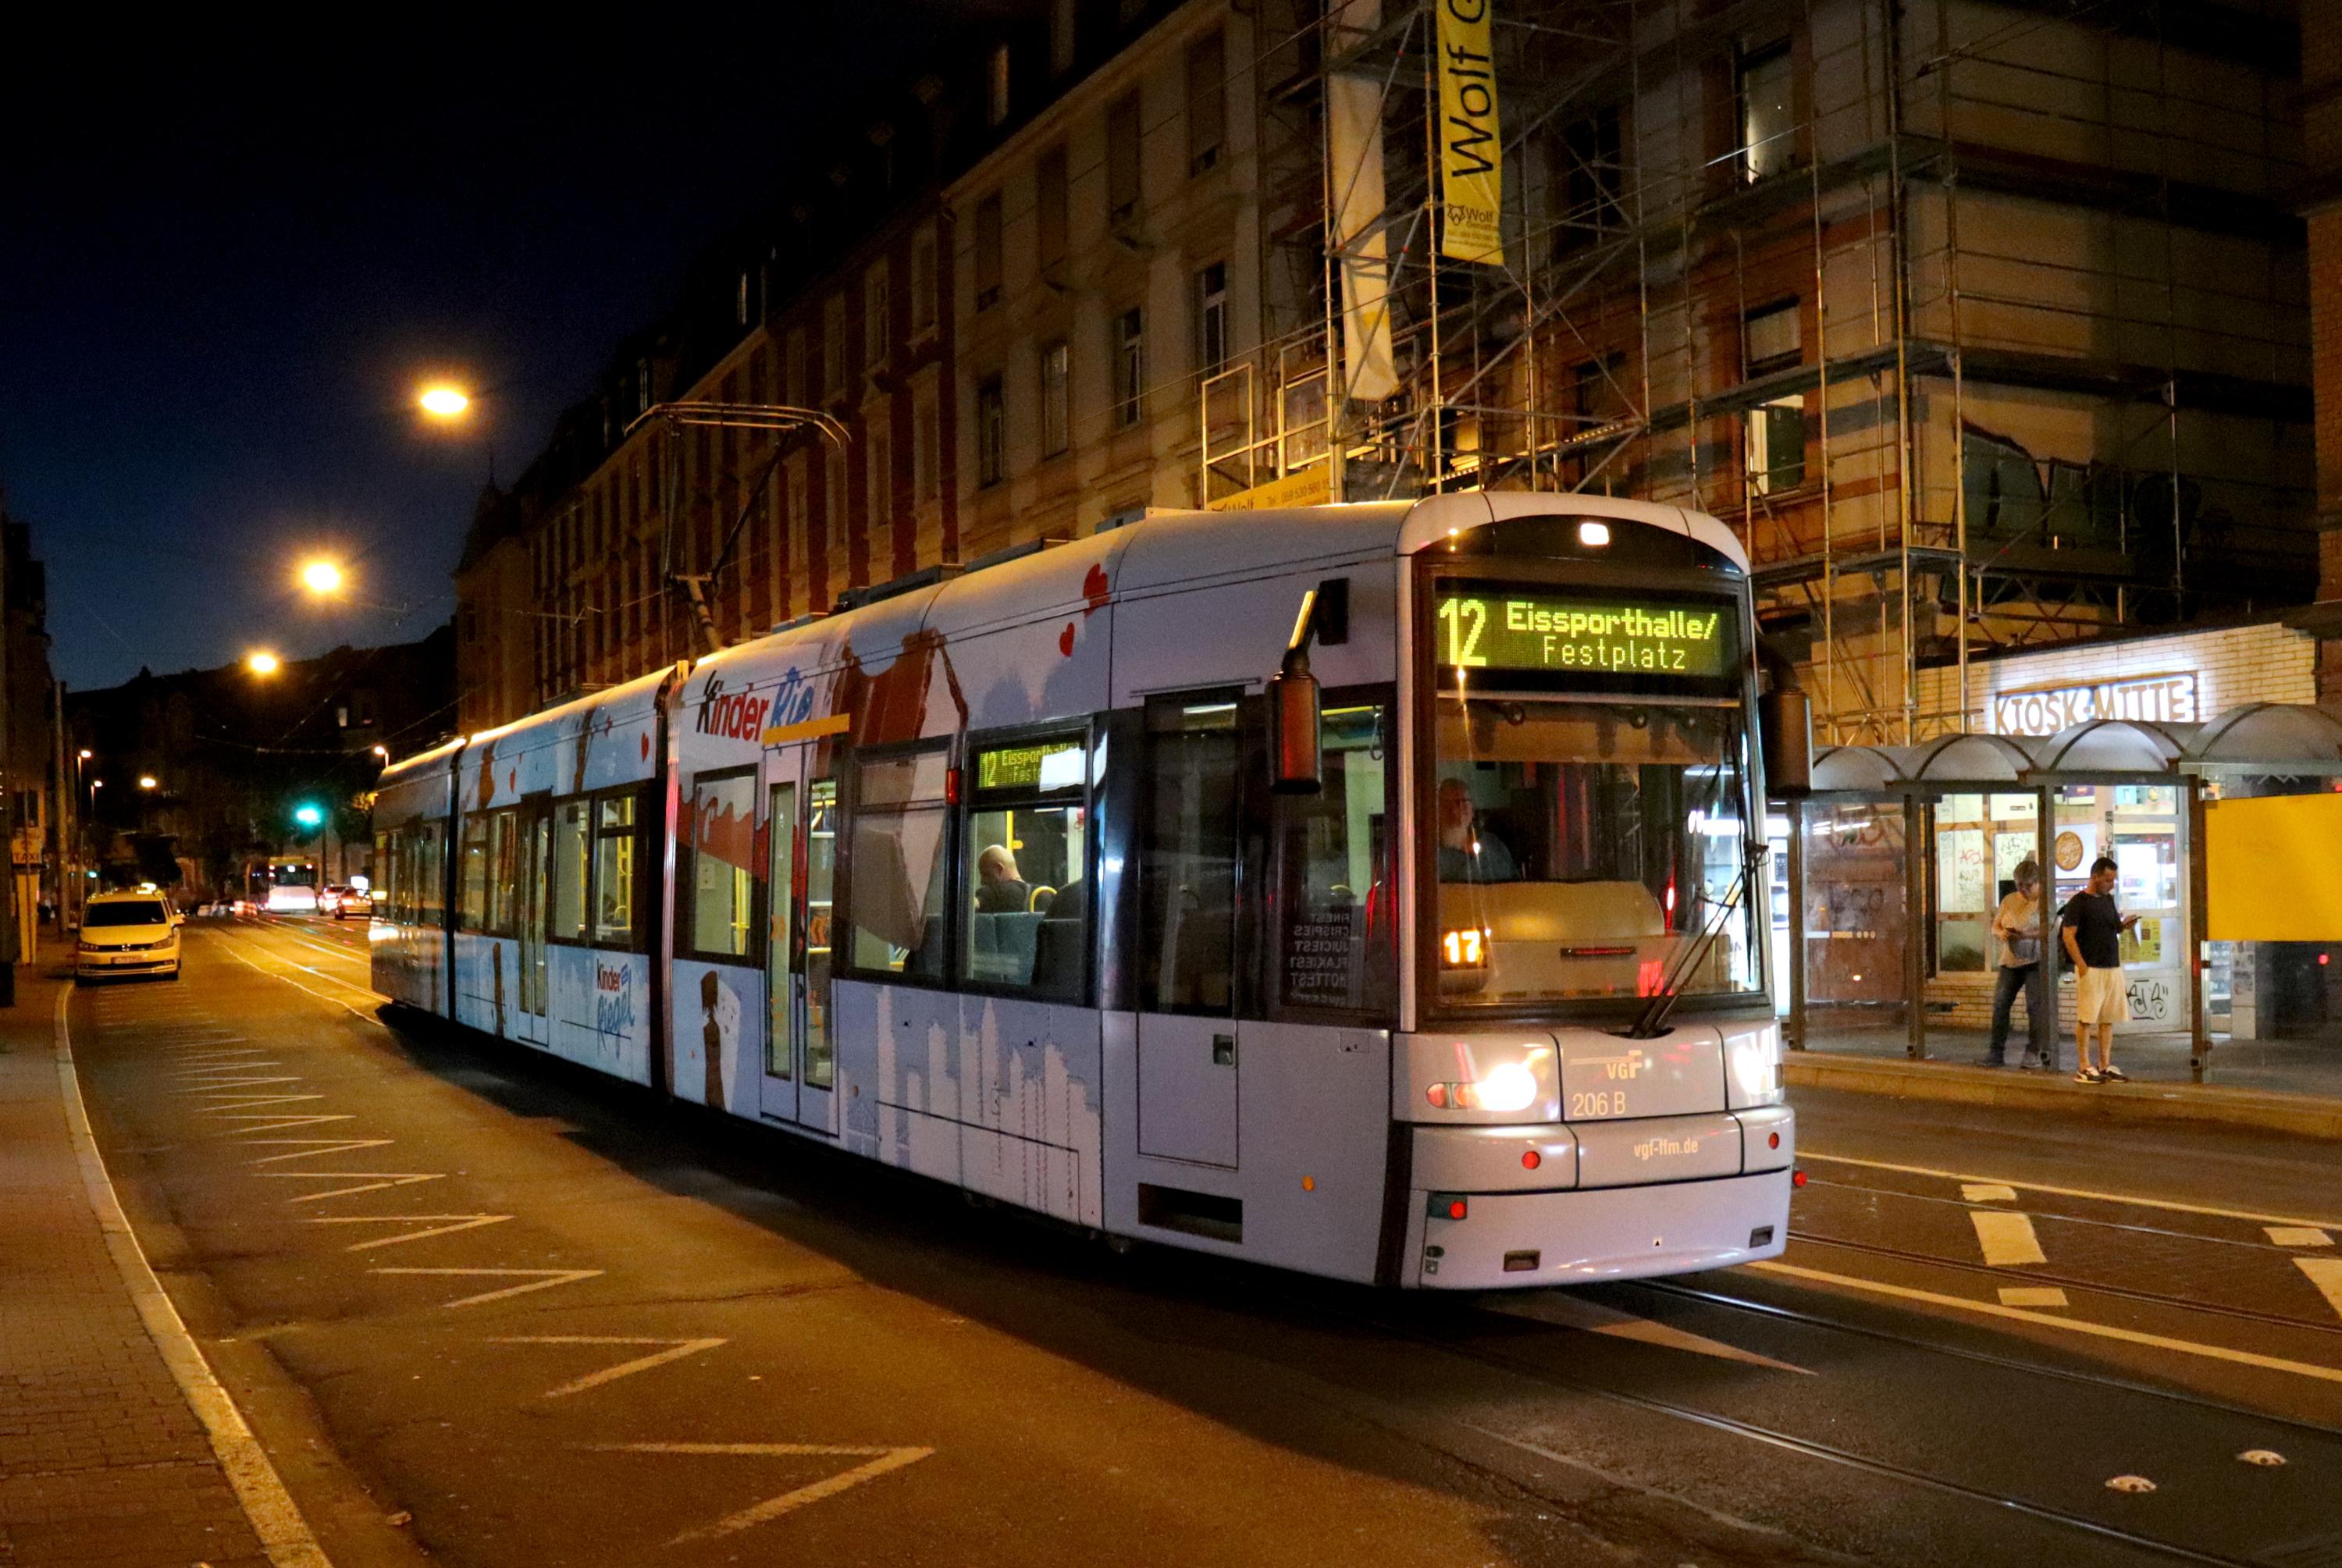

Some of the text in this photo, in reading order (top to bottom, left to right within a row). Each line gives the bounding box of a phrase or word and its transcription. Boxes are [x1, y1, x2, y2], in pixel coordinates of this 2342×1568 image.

[1447, 44, 1494, 178] Wolf
[1465, 207, 1493, 223] Wolf
[1439, 598, 1718, 667] 12 Eissporthalle/
[1543, 635, 1685, 672] Festplatz
[983, 751, 997, 788] 12
[14, 852, 39, 861] TAXI
[1444, 930, 1481, 964] 17
[1607, 1050, 1643, 1080] VGF
[1572, 1090, 1626, 1118] 206 B
[1633, 1137, 1700, 1161] vgf-ffm.de
